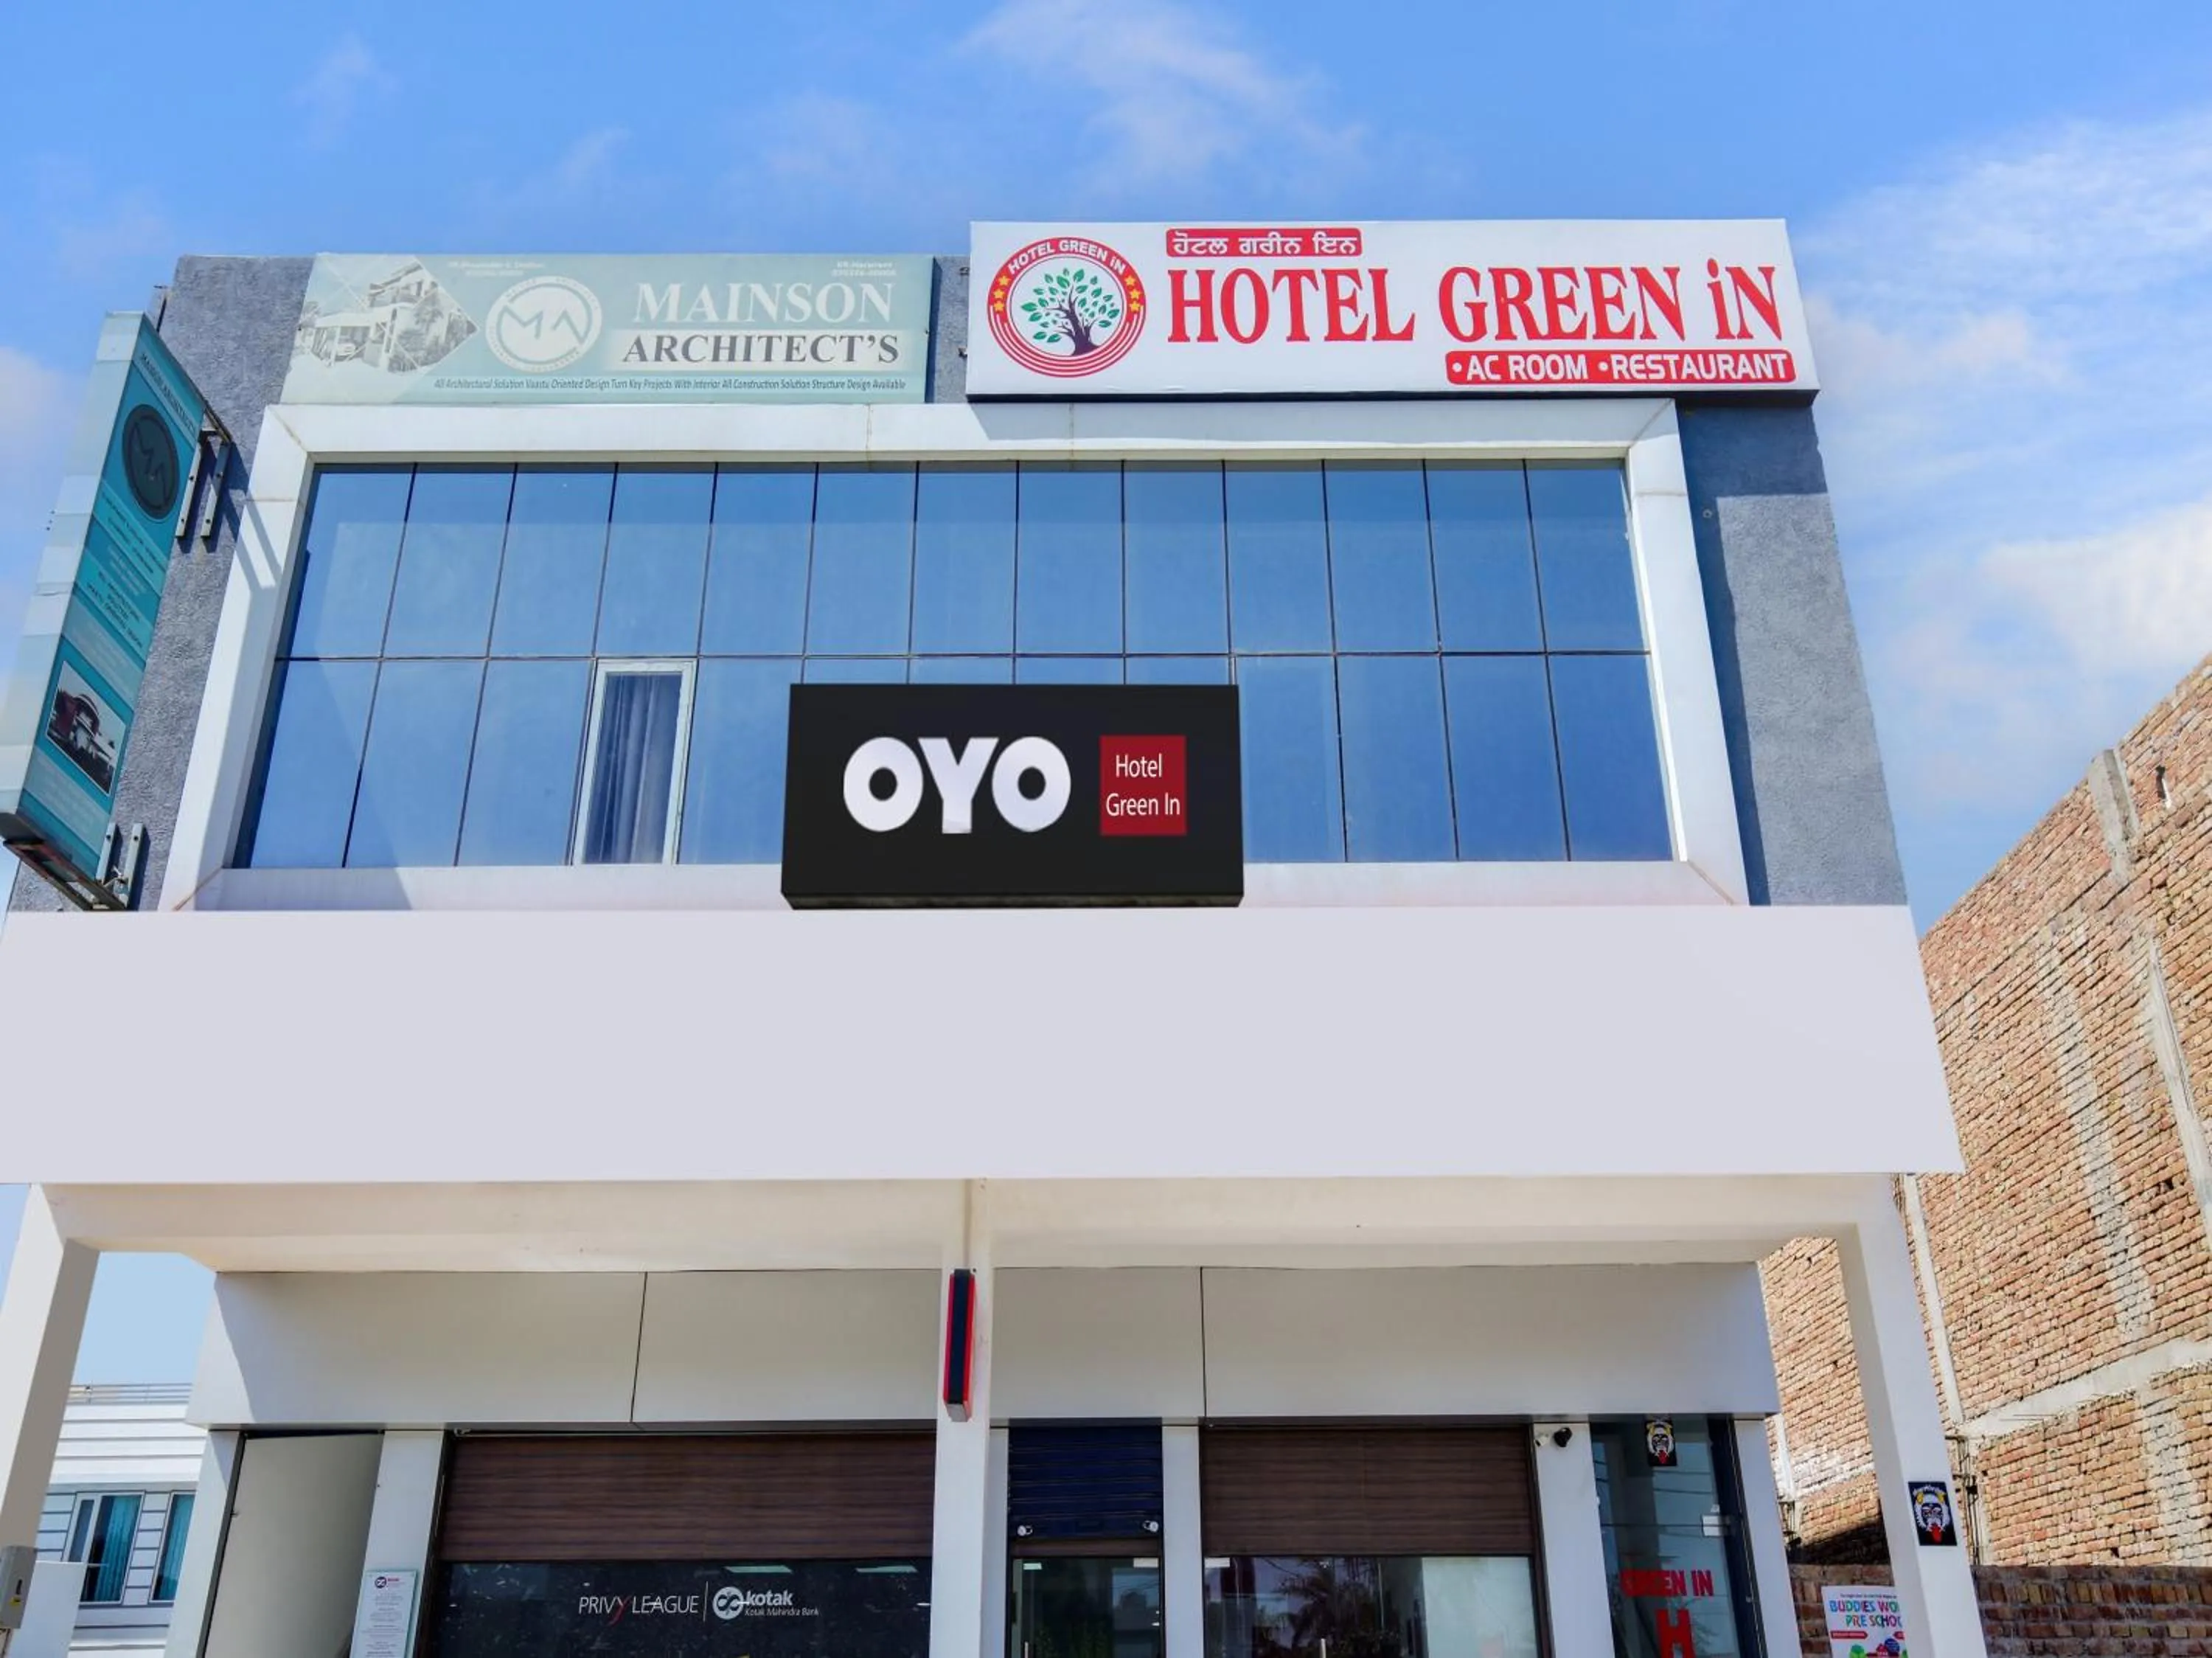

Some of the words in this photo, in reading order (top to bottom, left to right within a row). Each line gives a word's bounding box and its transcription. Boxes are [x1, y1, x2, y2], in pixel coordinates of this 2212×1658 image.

[1008, 242, 1055, 274] HOTEL
[1059, 240, 1108, 261] GREEN
[633, 282, 897, 324] MAINSON
[1167, 268, 1416, 344] HOTEL
[1438, 266, 1686, 342] GREEN
[622, 333, 899, 363] ARCHITECT'S
[1508, 354, 1588, 381] ROOM
[1610, 353, 1788, 380] RESTAURANT
[493, 378, 524, 389] Solution
[551, 378, 582, 389] Oriented
[585, 378, 609, 391] Design
[629, 378, 641, 390] Key
[734, 378, 779, 389] Construction
[781, 378, 810, 389] Solution
[812, 378, 845, 389] Structure
[847, 378, 871, 391] Design
[873, 378, 906, 389] Available
[1116, 754, 1163, 779] Hotel
[843, 736, 1071, 834] OYO
[1106, 793, 1159, 817] Green
[1165, 794, 1180, 816] In
[1691, 1569, 1714, 1597] IN
[632, 1595, 700, 1614] LEAGUE
[745, 1589, 793, 1606] kotak
[1829, 1600, 1877, 1613] BUDDIES
[1846, 1614, 1868, 1627] PRE
